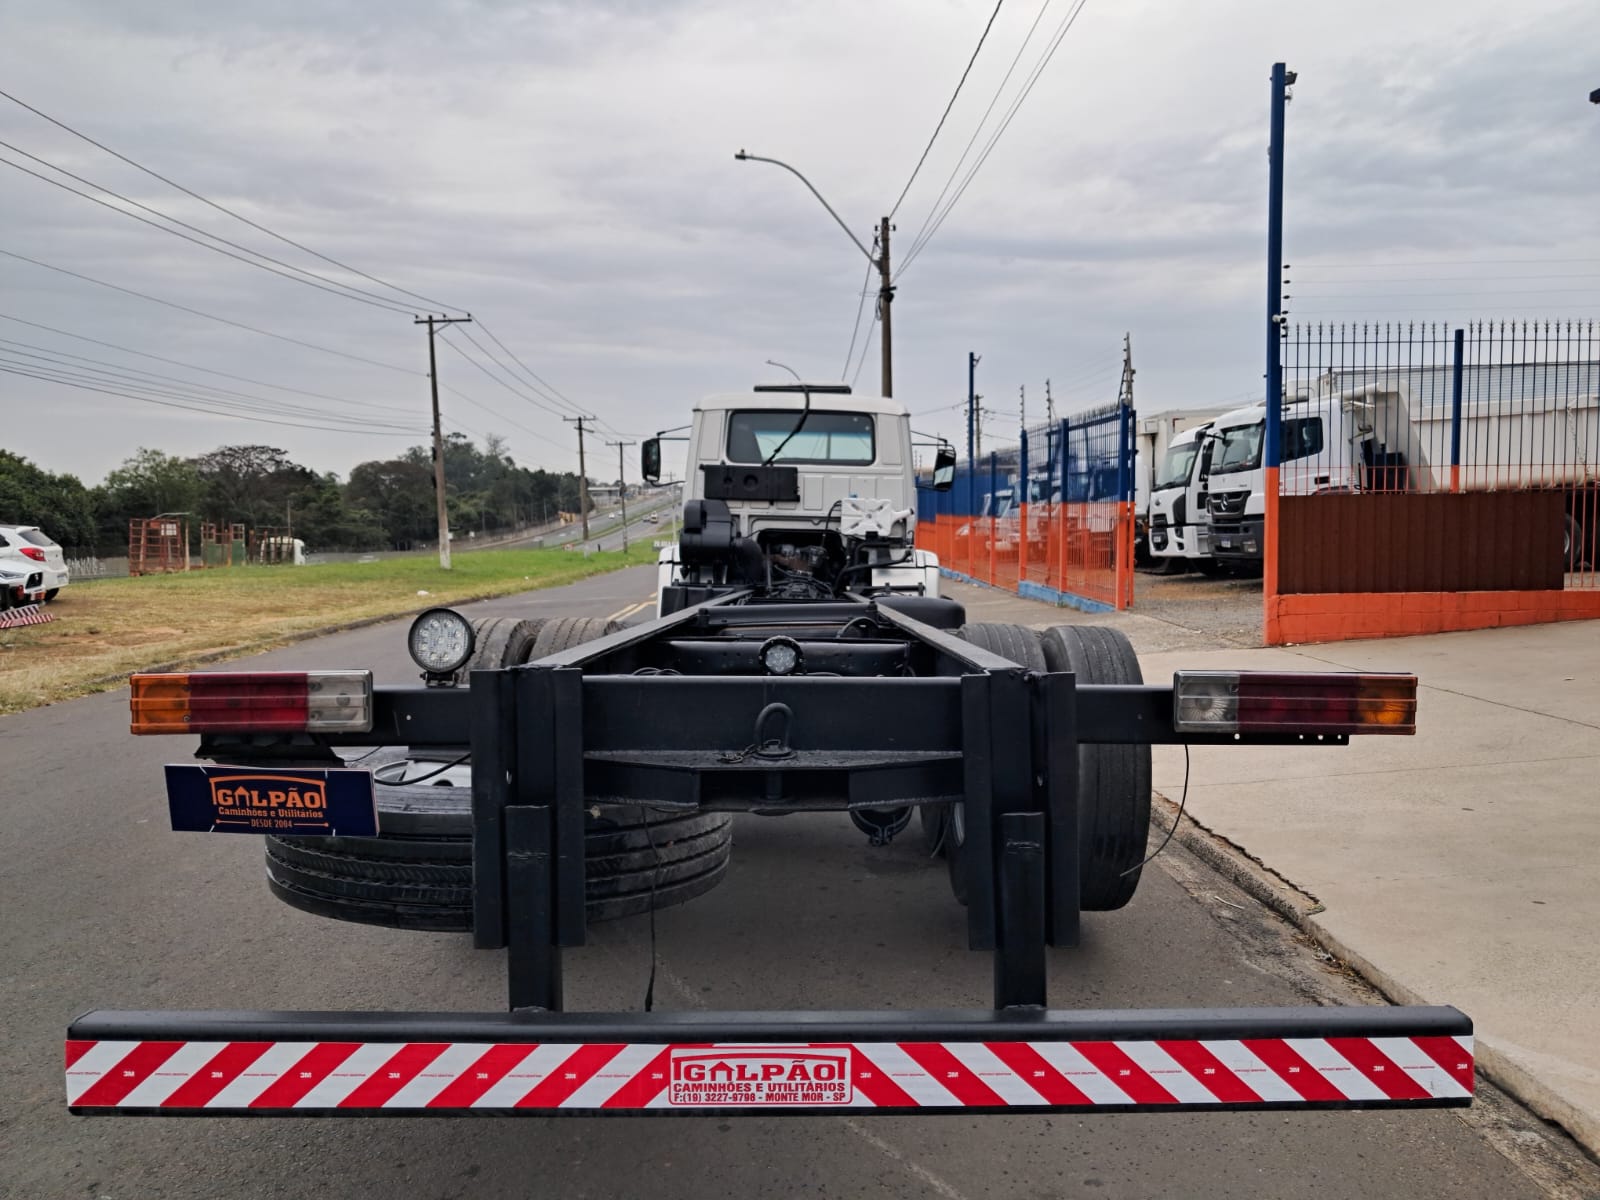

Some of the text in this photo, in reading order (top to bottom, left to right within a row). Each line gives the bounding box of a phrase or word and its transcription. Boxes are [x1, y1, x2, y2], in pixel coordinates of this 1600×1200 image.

[216, 786, 321, 808] GALPÃO
[218, 806, 268, 817] Caminhões
[278, 808, 323, 818] Utilitários
[251, 818, 293, 829] DESDE 2004
[683, 1059, 837, 1082] GALPÃO
[674, 1081, 845, 1092] CAMINHÕES E UTILITÁRIOS
[705, 1092, 756, 1102] 3227-9798
[765, 1092, 799, 1102] MONTE
[802, 1092, 824, 1102] MOR
[833, 1092, 846, 1102] SP
